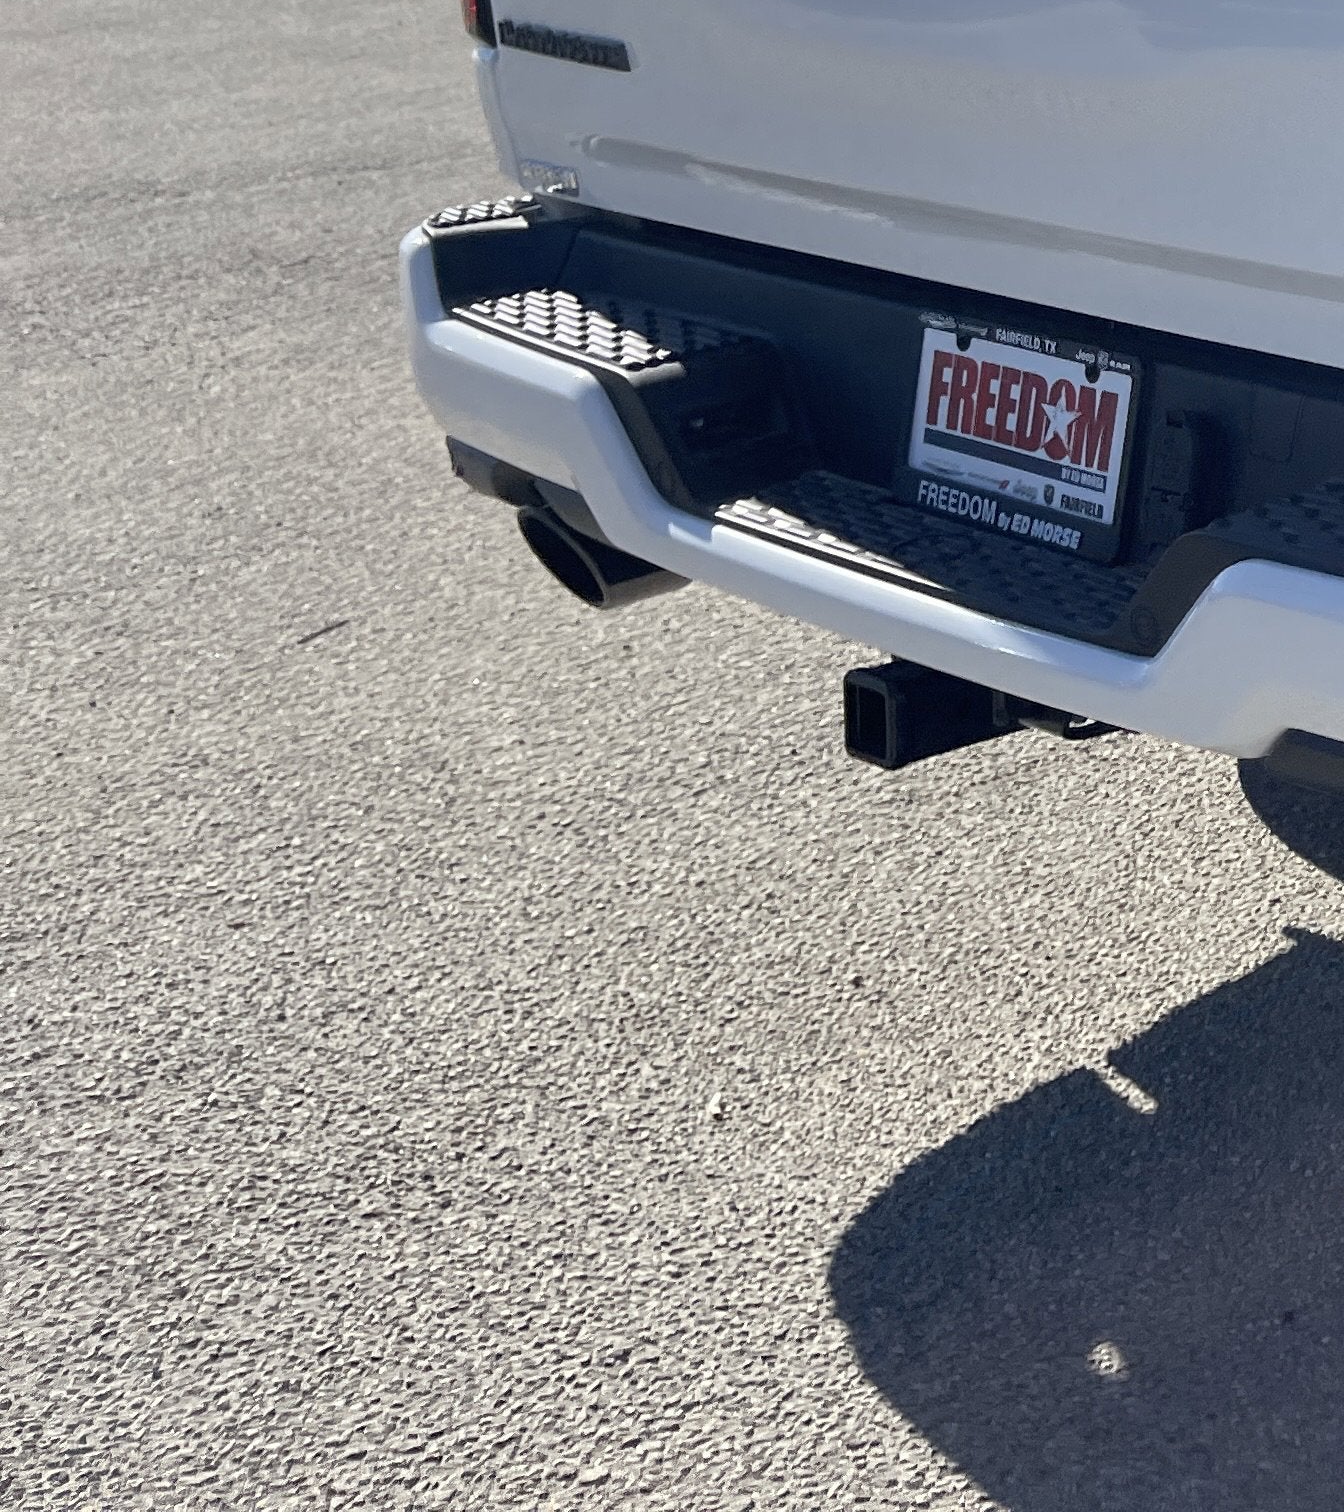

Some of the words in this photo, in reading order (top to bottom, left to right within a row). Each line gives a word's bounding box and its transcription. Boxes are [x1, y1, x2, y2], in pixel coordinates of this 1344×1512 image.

[1043, 339, 1058, 354] TX
[926, 350, 1118, 472] FREEDOM
[917, 479, 997, 525] FREEDOM
[997, 512, 1011, 531] by
[1010, 513, 1030, 534] ED
[1030, 519, 1082, 551] MORSE
